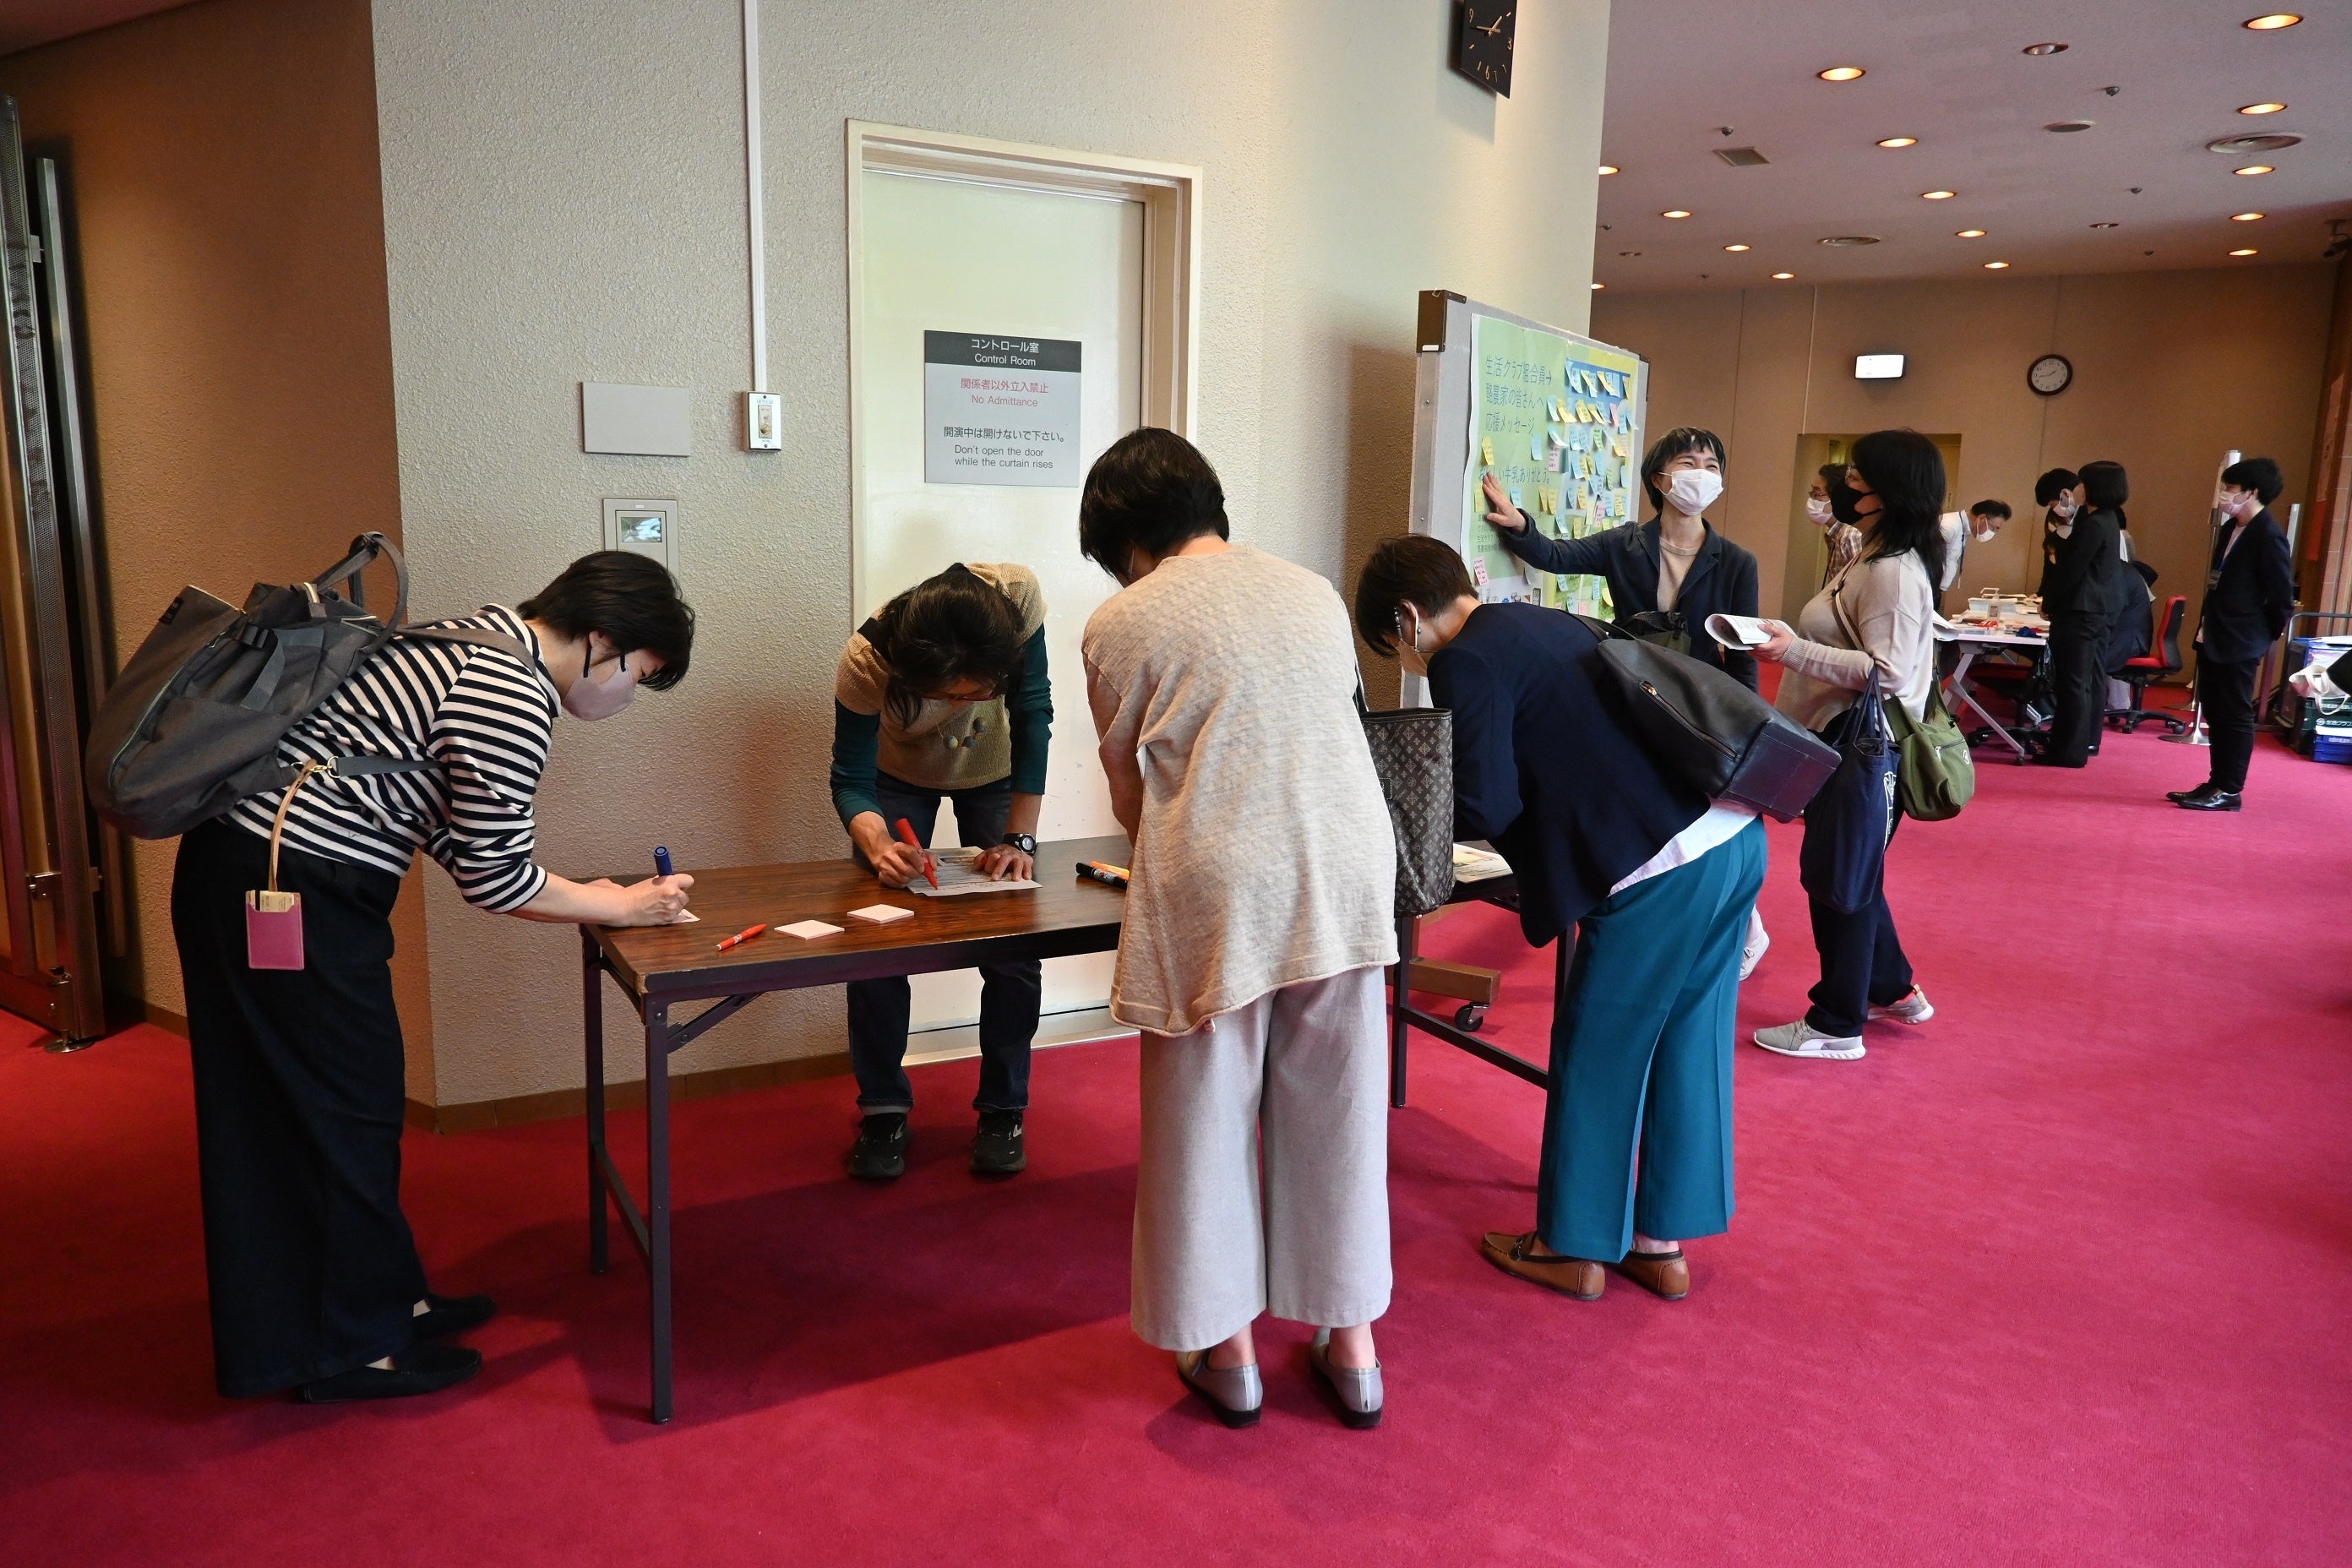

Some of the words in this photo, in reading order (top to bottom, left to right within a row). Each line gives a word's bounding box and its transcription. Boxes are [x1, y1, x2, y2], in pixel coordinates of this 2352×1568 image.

[971, 339, 1039, 353] コントロール室
[974, 353, 1007, 364] Control
[1010, 356, 1037, 367] Room
[961, 378, 1048, 394] 関係者以外立入禁止
[972, 395, 984, 404] No
[988, 395, 1038, 407] Admittance
[944, 426, 1064, 443] 開演中は開けないで下さい。
[955, 444, 978, 454] Don't
[982, 447, 1004, 456] open
[1007, 447, 1021, 456] the
[1024, 448, 1044, 456] door
[955, 457, 978, 466] while
[982, 458, 996, 467] the
[999, 459, 1030, 468] curtain
[1032, 460, 1054, 469] rises
